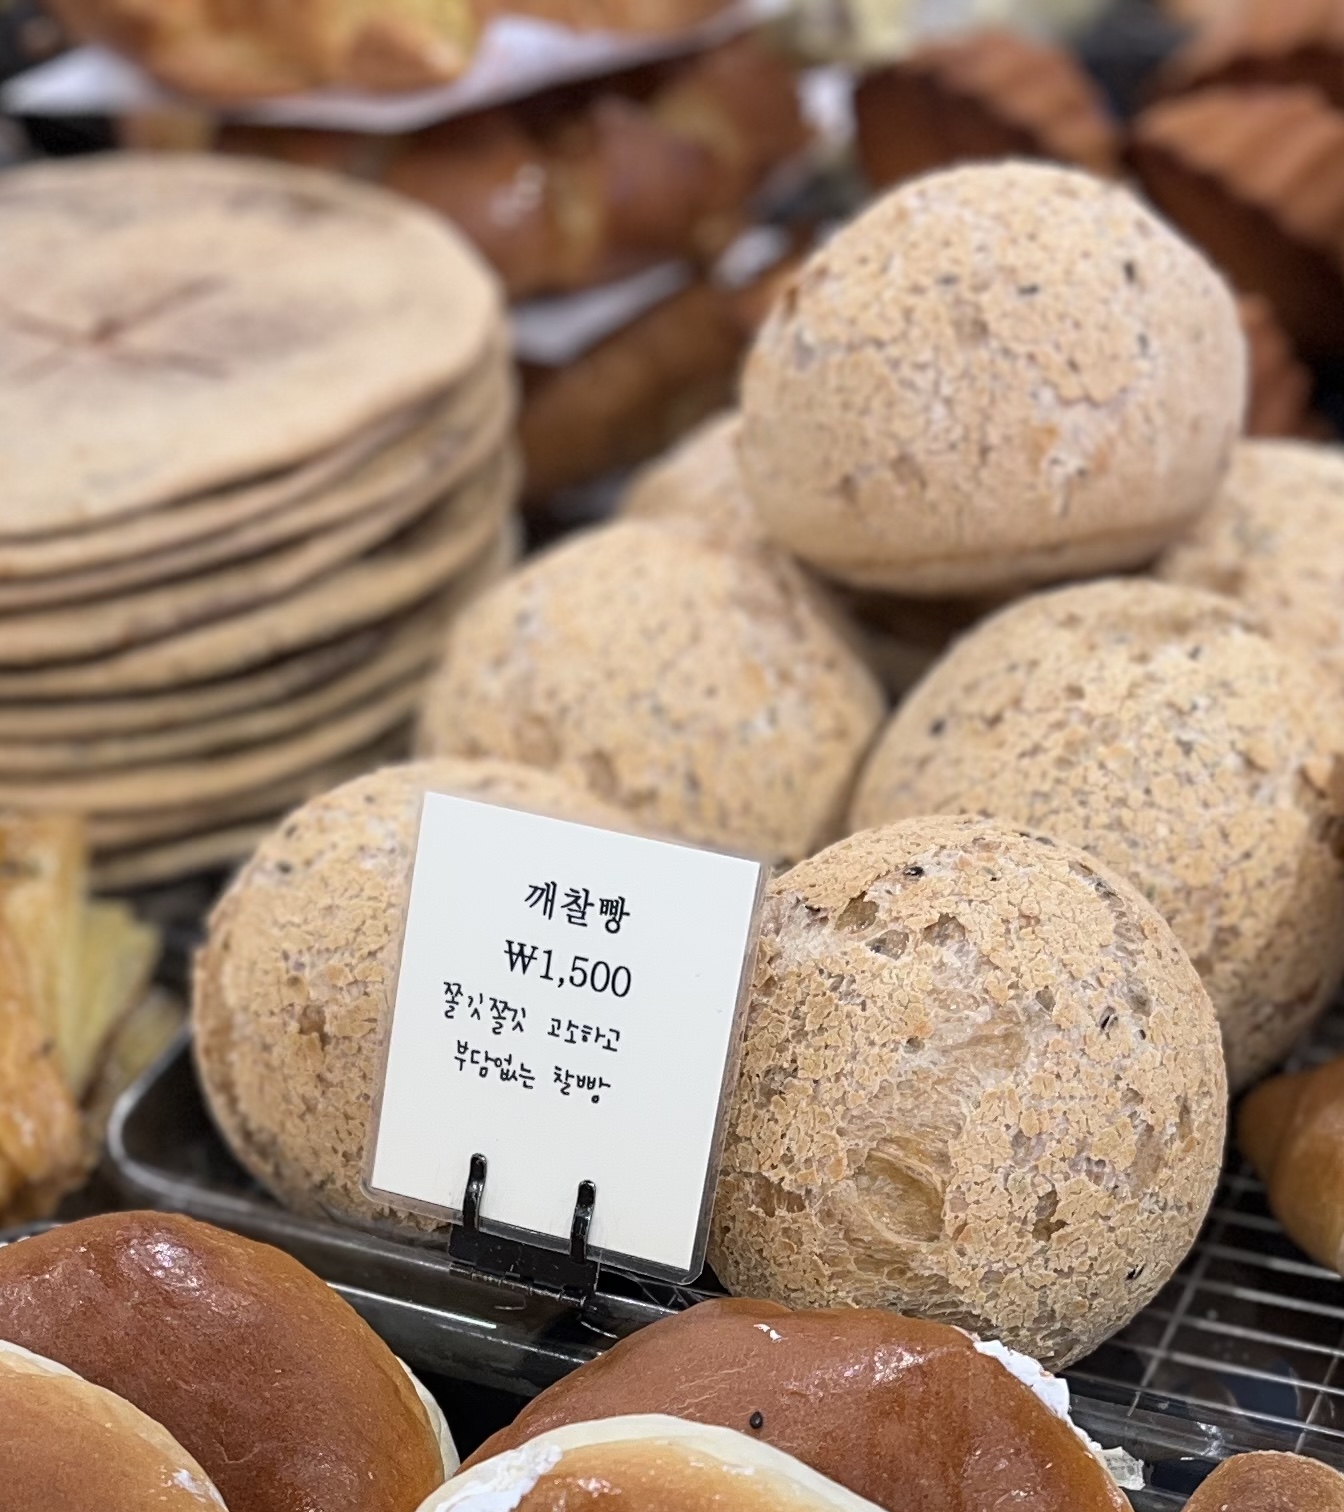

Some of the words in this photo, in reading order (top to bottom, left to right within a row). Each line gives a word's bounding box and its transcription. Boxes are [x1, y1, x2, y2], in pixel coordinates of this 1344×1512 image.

[525, 881, 630, 934] 깨찰빵
[504, 940, 631, 997] ₩1,500
[443, 982, 526, 1035] 쫄깃쫄깃
[548, 1018, 620, 1052] 고소하고
[455, 1040, 535, 1089] 부담없는
[554, 1066, 611, 1103] 찰빵
